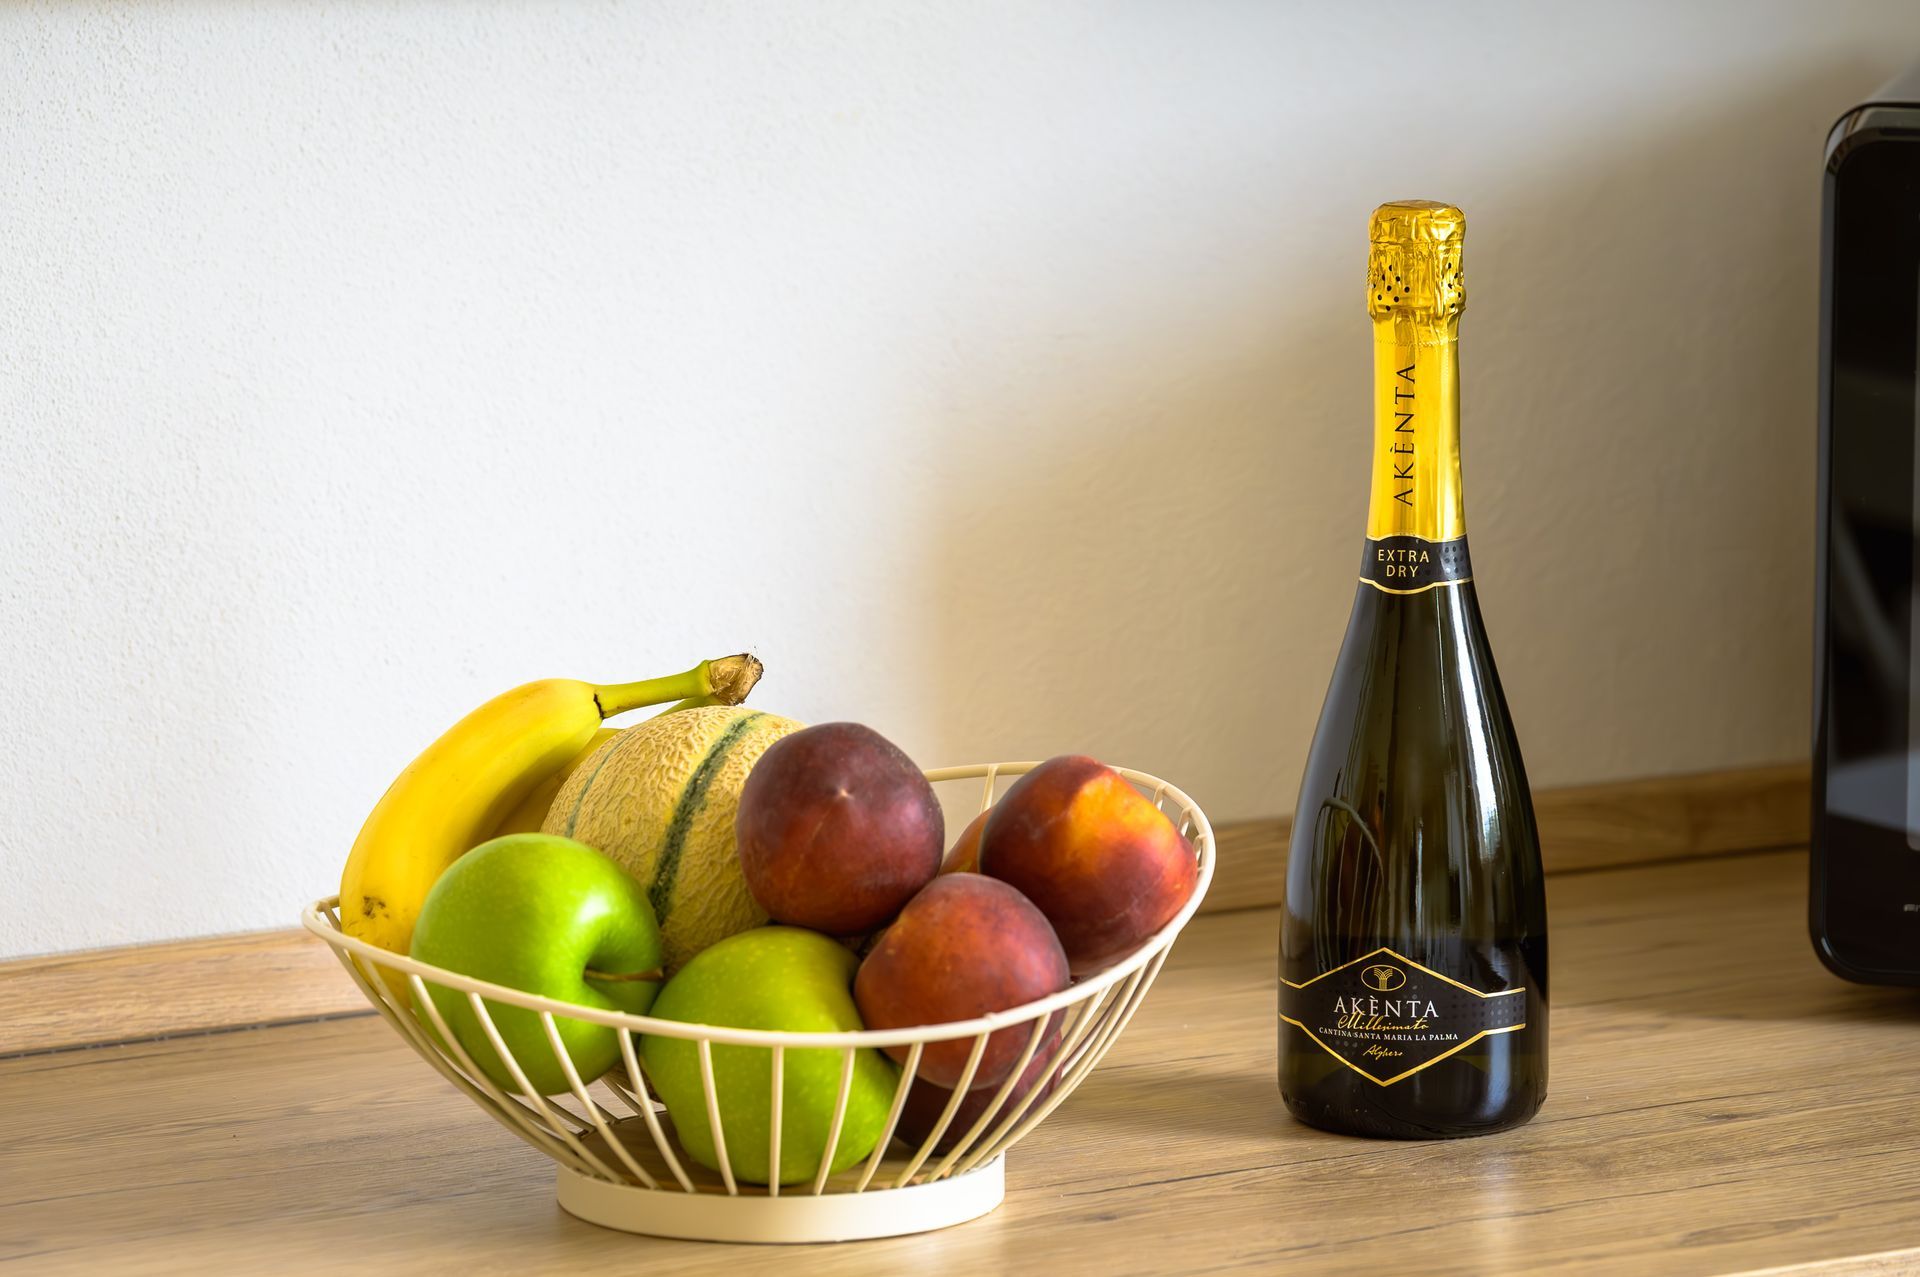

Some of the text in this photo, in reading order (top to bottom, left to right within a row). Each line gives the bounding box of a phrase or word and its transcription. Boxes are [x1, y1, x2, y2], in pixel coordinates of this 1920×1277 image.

[1389, 363, 1416, 507] AKÈNTA
[1377, 549, 1430, 564] EXTRA
[1386, 565, 1419, 578] DRY
[1333, 994, 1439, 1018] AKÈNTA
[1337, 1010, 1429, 1031] Millesimato
[1318, 1026, 1459, 1041] CANTINA SANTA MARIA LA PALMA
